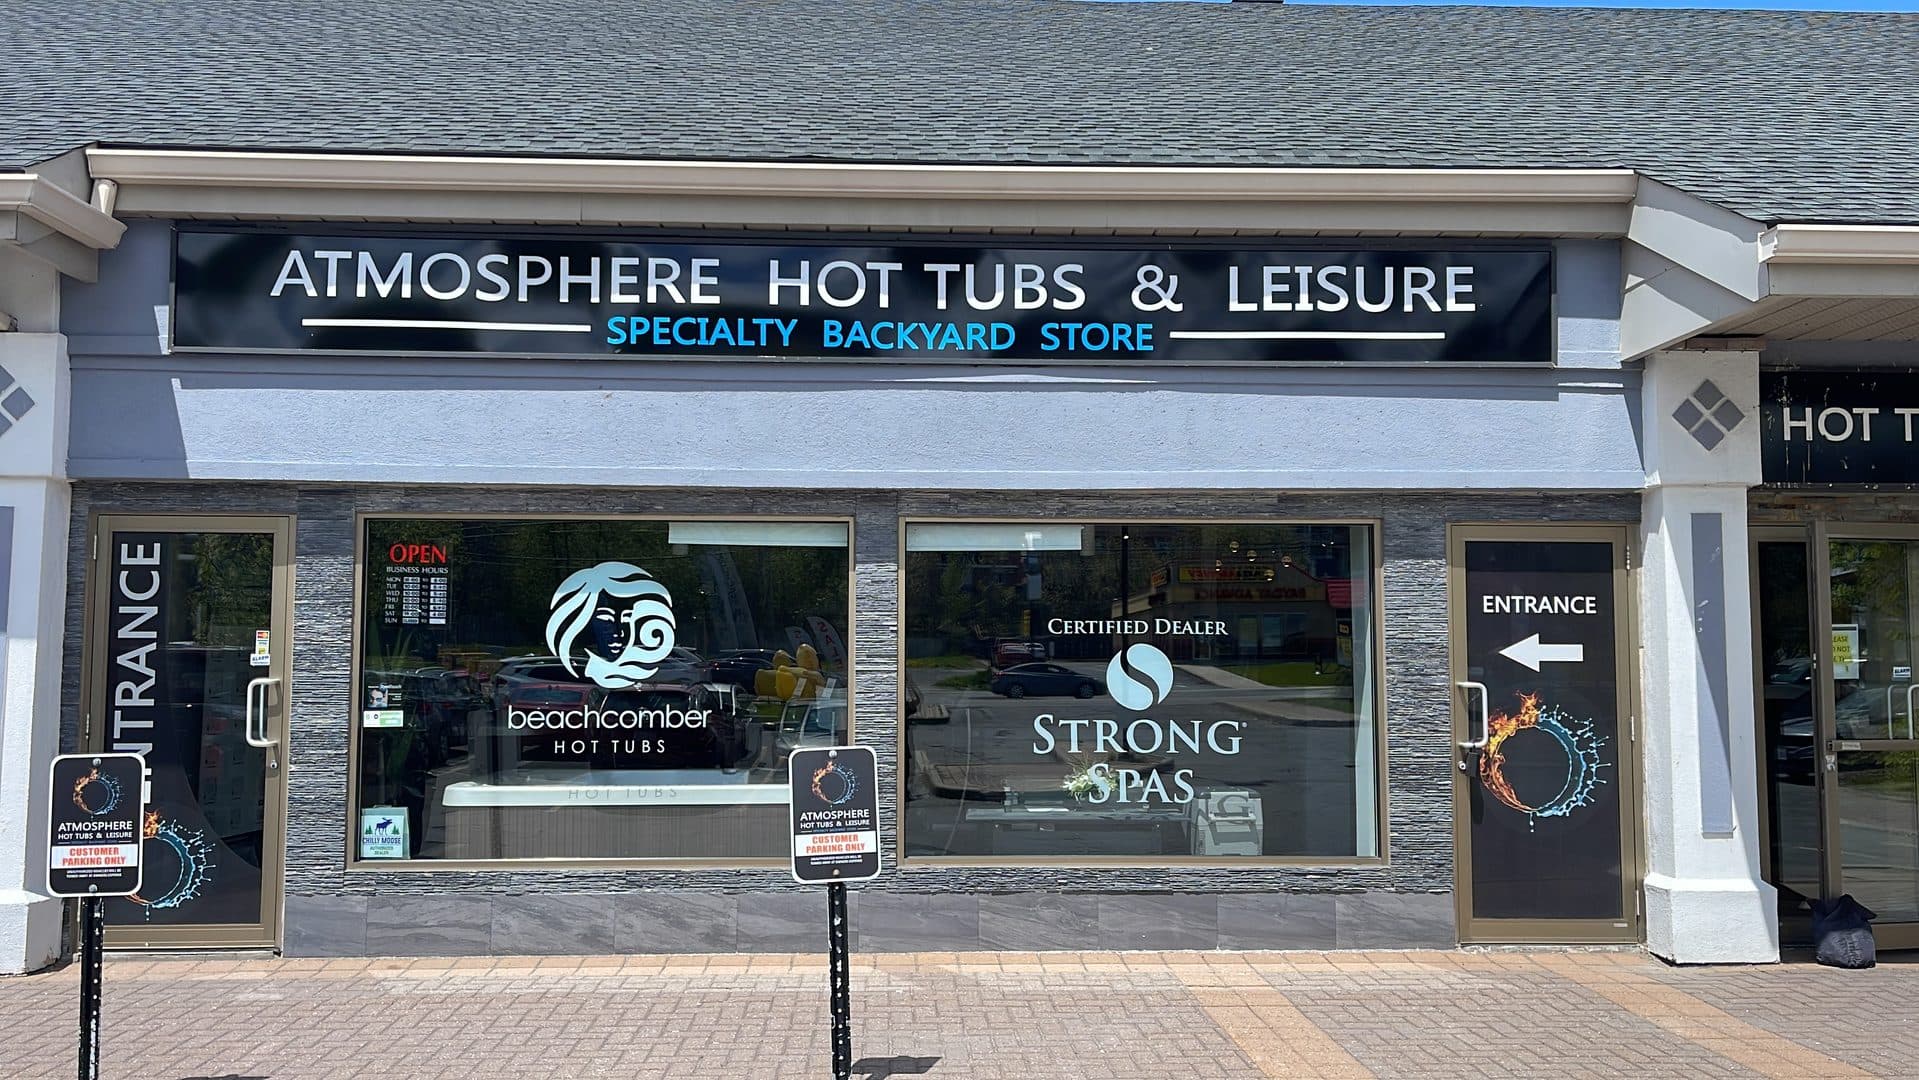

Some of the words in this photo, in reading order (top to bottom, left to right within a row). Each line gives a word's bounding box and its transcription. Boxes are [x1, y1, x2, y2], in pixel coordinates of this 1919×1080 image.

[270, 249, 720, 304] ATMOSPHERE
[769, 260, 902, 308] HOT
[924, 263, 1085, 311] TUBS
[1130, 264, 1184, 313] &
[1229, 265, 1476, 313] LEISURE
[607, 316, 798, 348] SPECIALTY
[823, 320, 1015, 351] BACKYARD
[1040, 322, 1154, 351] STORE
[1783, 407, 1880, 441] HOT
[389, 543, 447, 564] OPEN
[1482, 595, 1597, 614] ENTRANCE
[1048, 618, 1149, 635] CERTIFIED
[1154, 618, 1229, 636] DEALER
[102, 542, 161, 804] NTRANCE
[507, 704, 713, 730] beachcomber
[1033, 713, 1243, 755] STRONG
[554, 739, 599, 754] HOT
[611, 739, 665, 754] TUBS
[1088, 763, 1195, 804] SPAS
[800, 809, 870, 821] ATMOSPHERE
[58, 821, 133, 832] ATMOSPHERE
[806, 844, 843, 854] PARKING
[845, 843, 865, 851] ONLY
[812, 834, 858, 844] CUSTOMER
[62, 857, 102, 866] PARKING
[104, 856, 126, 865] ONLY
[69, 847, 119, 856] CUSTOMER
